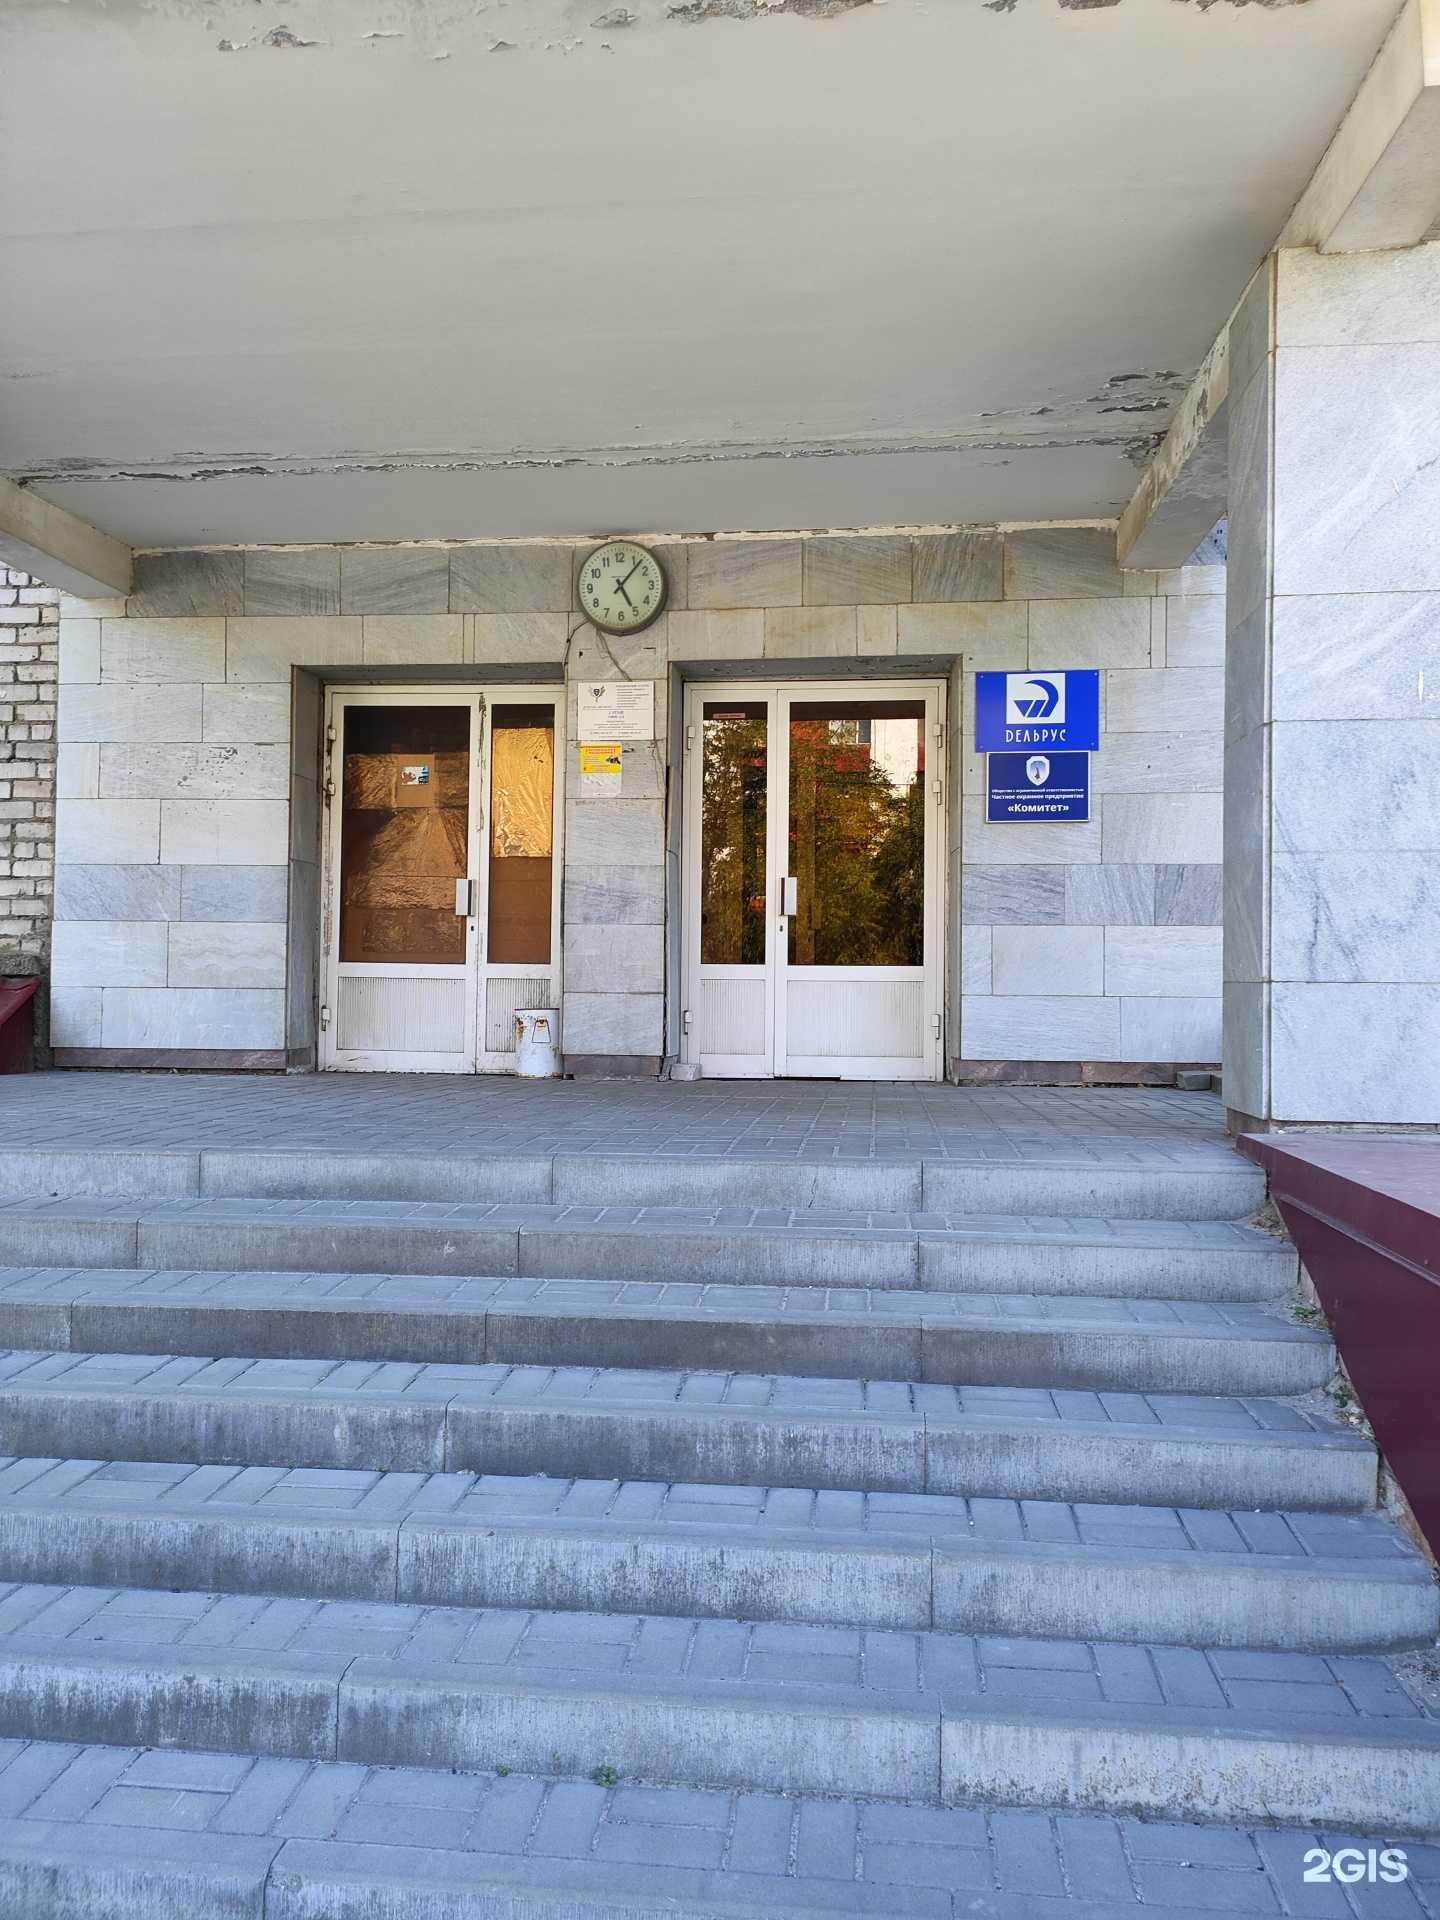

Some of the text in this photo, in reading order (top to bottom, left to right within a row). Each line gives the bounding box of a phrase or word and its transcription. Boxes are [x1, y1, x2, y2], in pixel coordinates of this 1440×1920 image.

[602, 557, 610, 568] 11
[615, 552, 625, 563] 12
[591, 568, 601, 579] 10
[642, 566, 649, 577] 2
[586, 583, 594, 594] 9
[648, 580, 655, 591] 3
[593, 598, 599, 608] 8
[643, 595, 650, 605] 4
[603, 607, 610, 618] 7
[617, 611, 625, 621] 6
[632, 606, 639, 617] 5
[1007, 803, 1069, 812] «Комитет»
